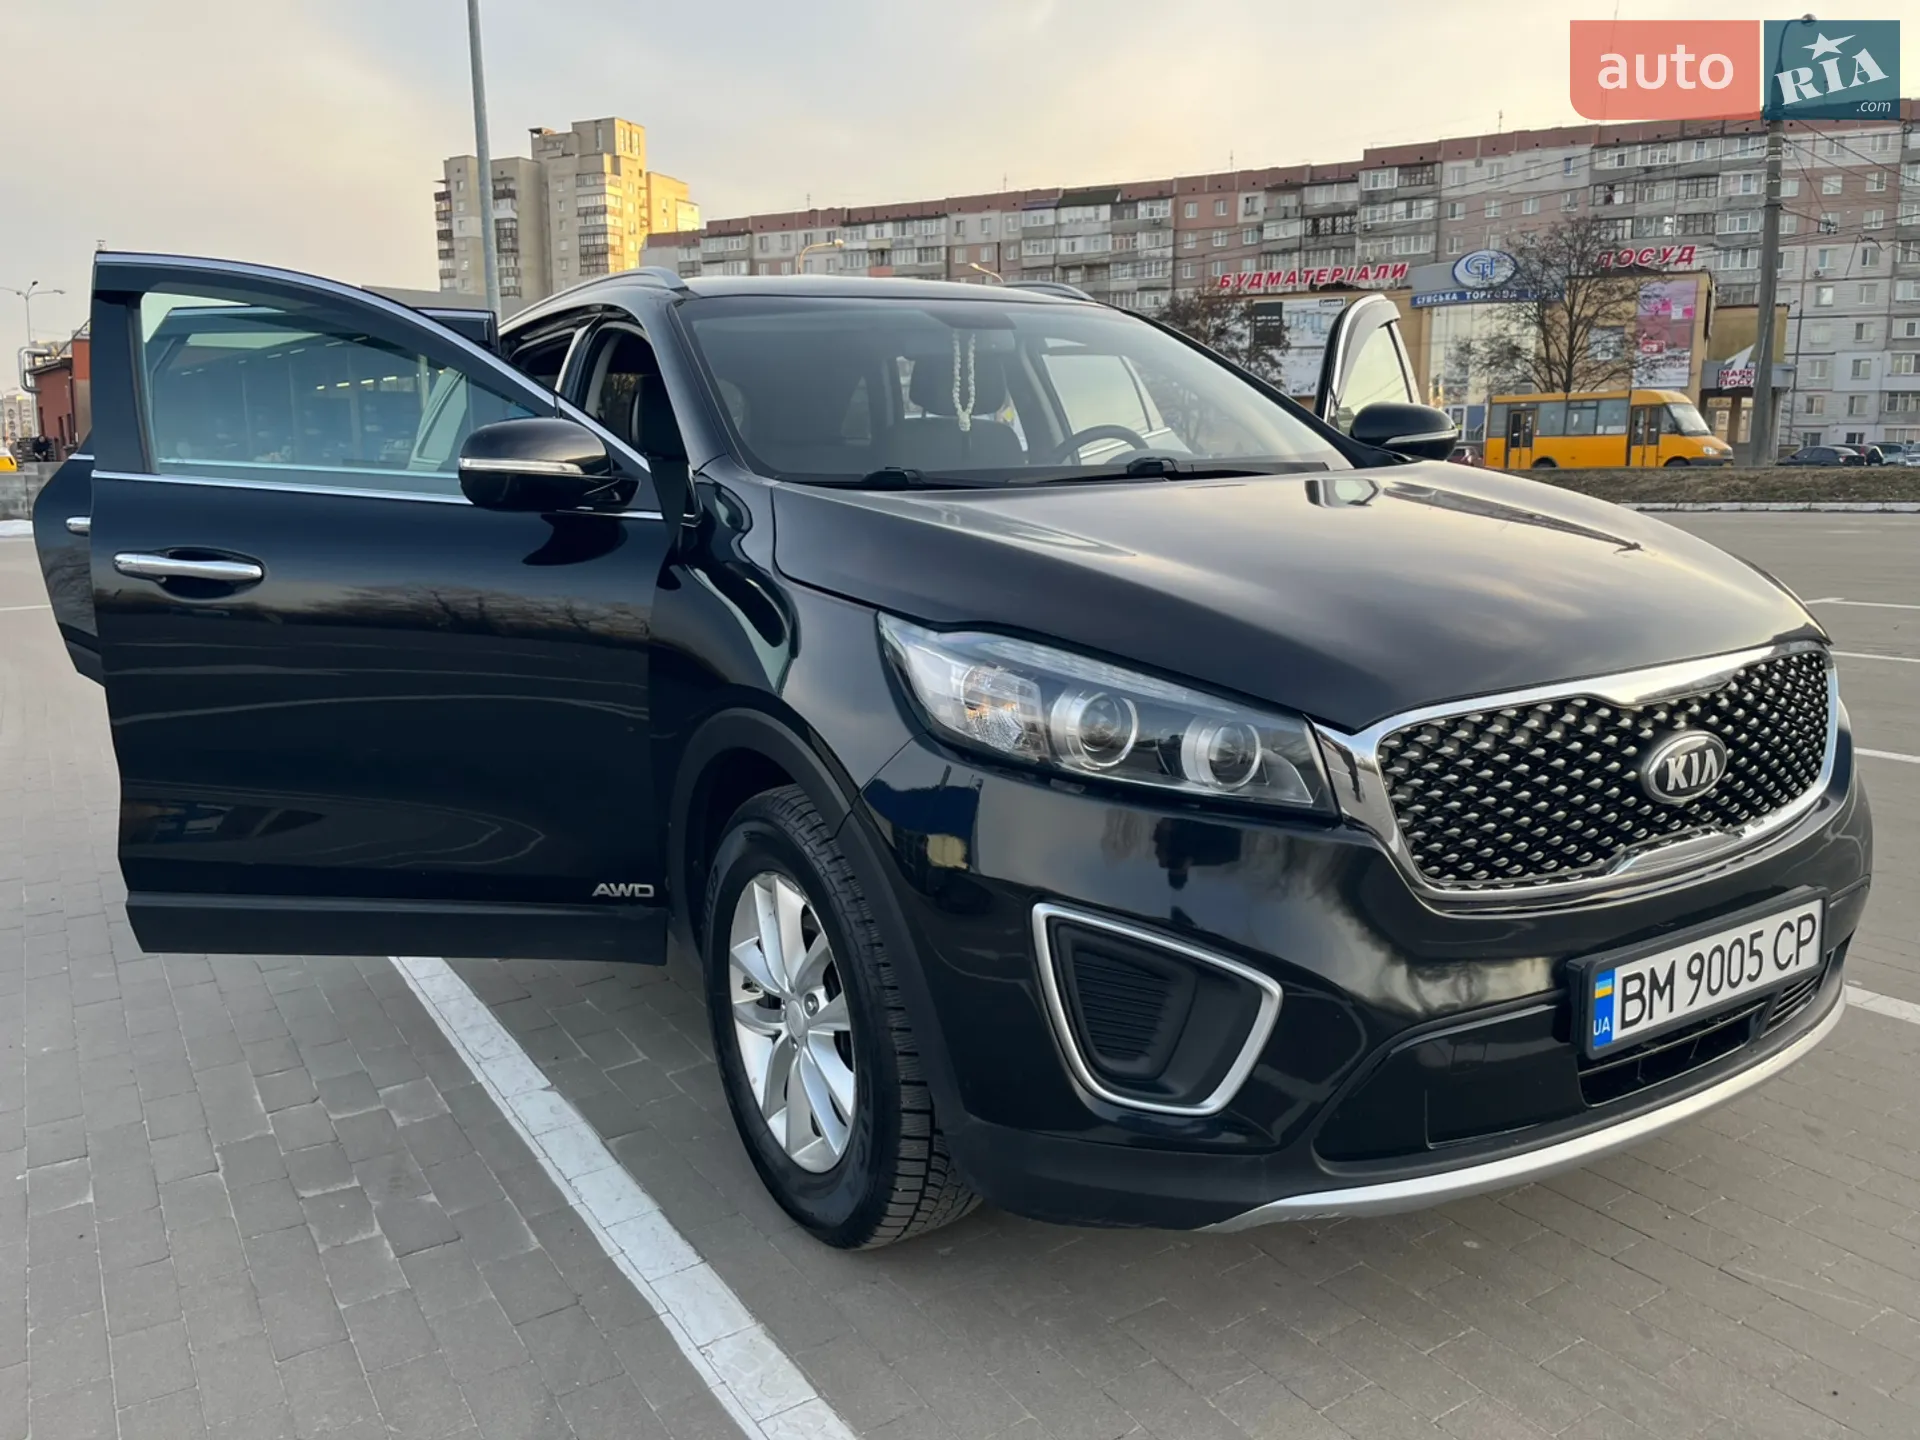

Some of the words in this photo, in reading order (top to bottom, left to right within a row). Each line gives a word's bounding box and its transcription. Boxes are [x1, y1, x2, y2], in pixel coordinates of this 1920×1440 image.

[1596, 245, 1697, 268] ПОСУД
[1218, 262, 1410, 290] БУДМАТЕРІАЛИ
[1719, 378, 1753, 387] ПОСУ
[1665, 748, 1718, 793] KIA
[591, 882, 655, 898] AWD
[1620, 959, 1676, 1030] BM
[1686, 929, 1764, 1007] 9005
[1773, 912, 1817, 971] CP
[1593, 1016, 1611, 1036] UA
